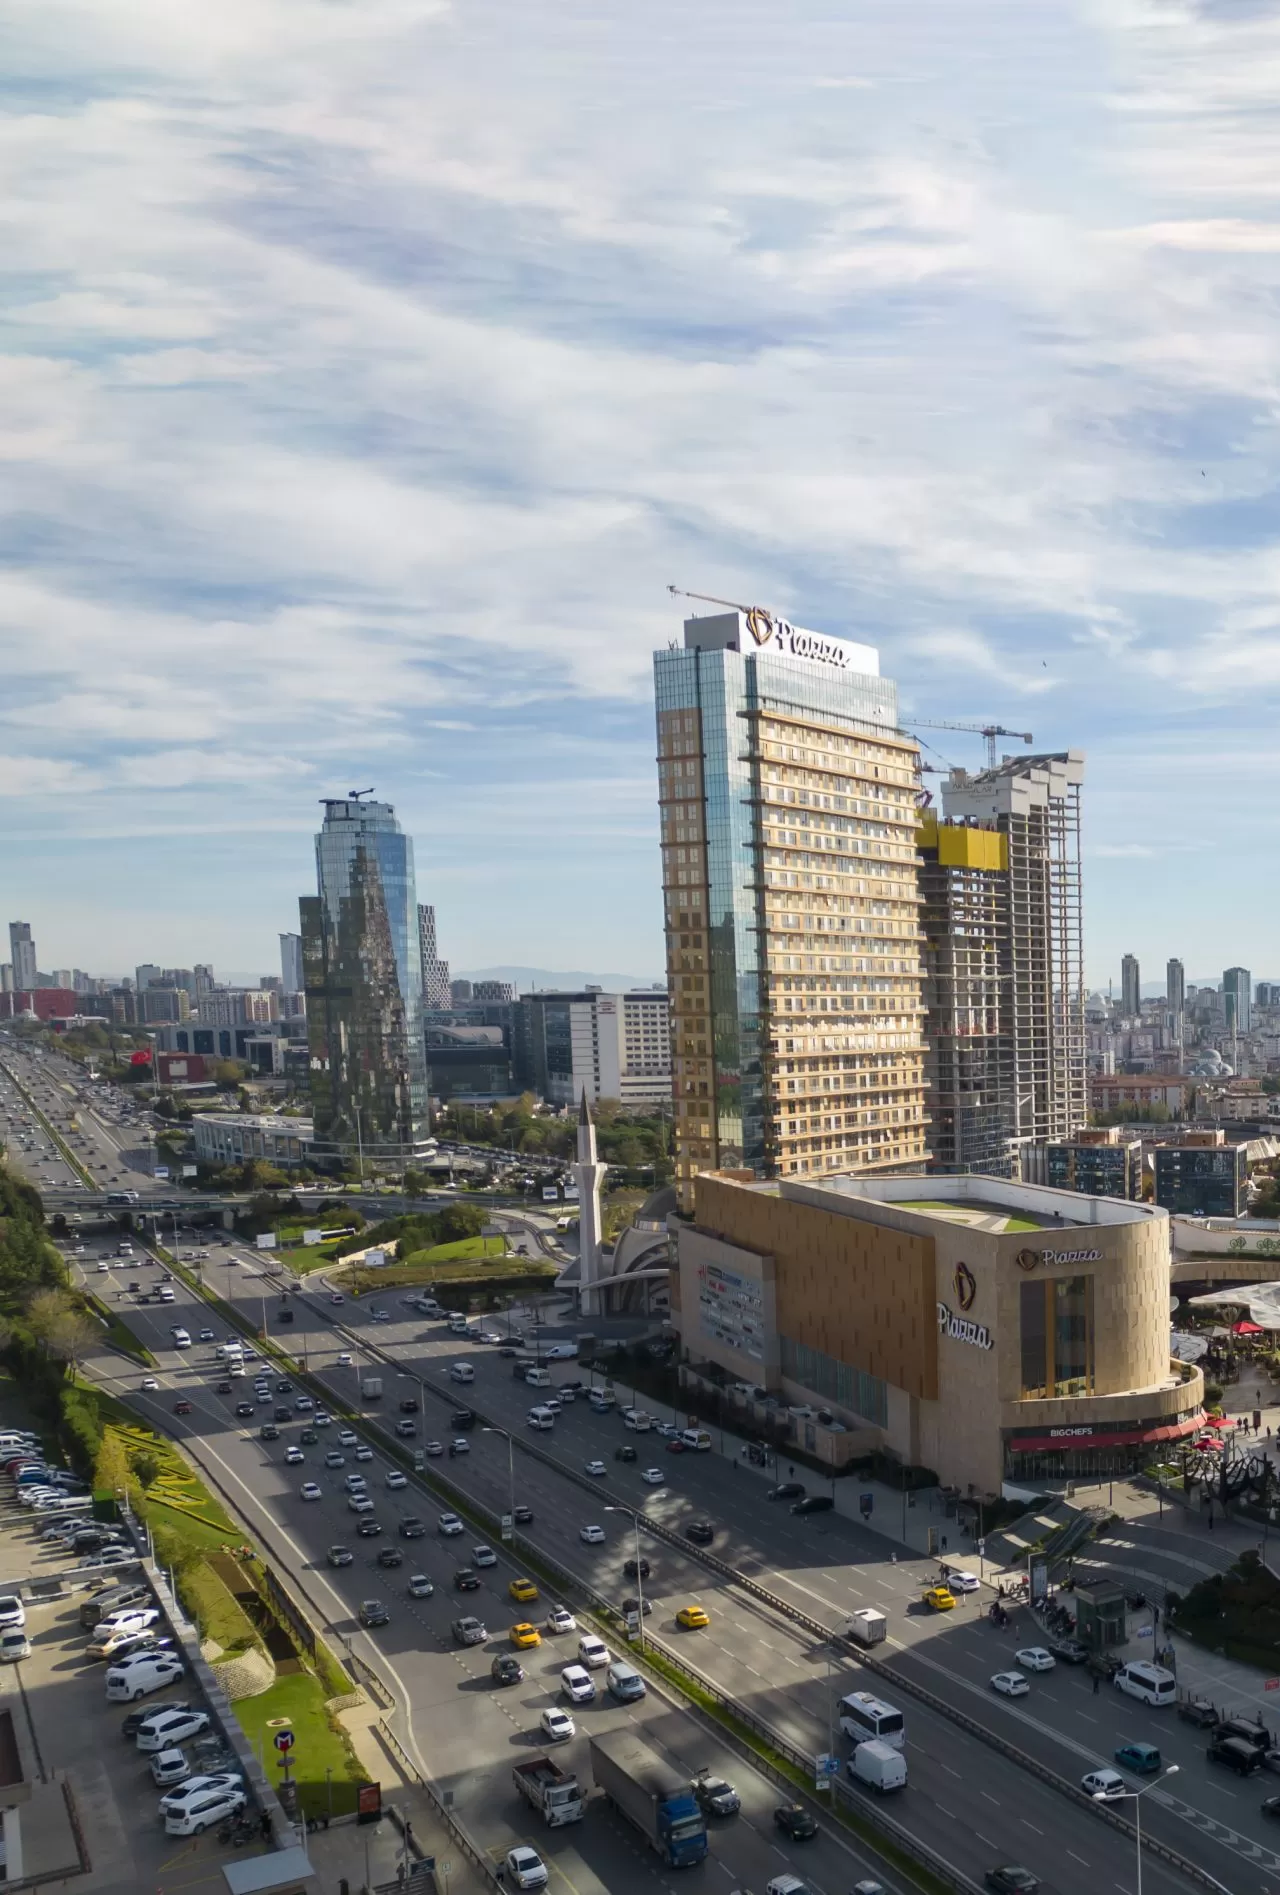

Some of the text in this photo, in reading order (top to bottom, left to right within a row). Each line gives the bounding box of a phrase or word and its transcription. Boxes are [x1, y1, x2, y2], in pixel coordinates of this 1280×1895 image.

[1041, 1250, 1103, 1266] Piazza
[936, 1302, 994, 1351] Piazza
[1050, 1427, 1093, 1437] BIGCHEFS
